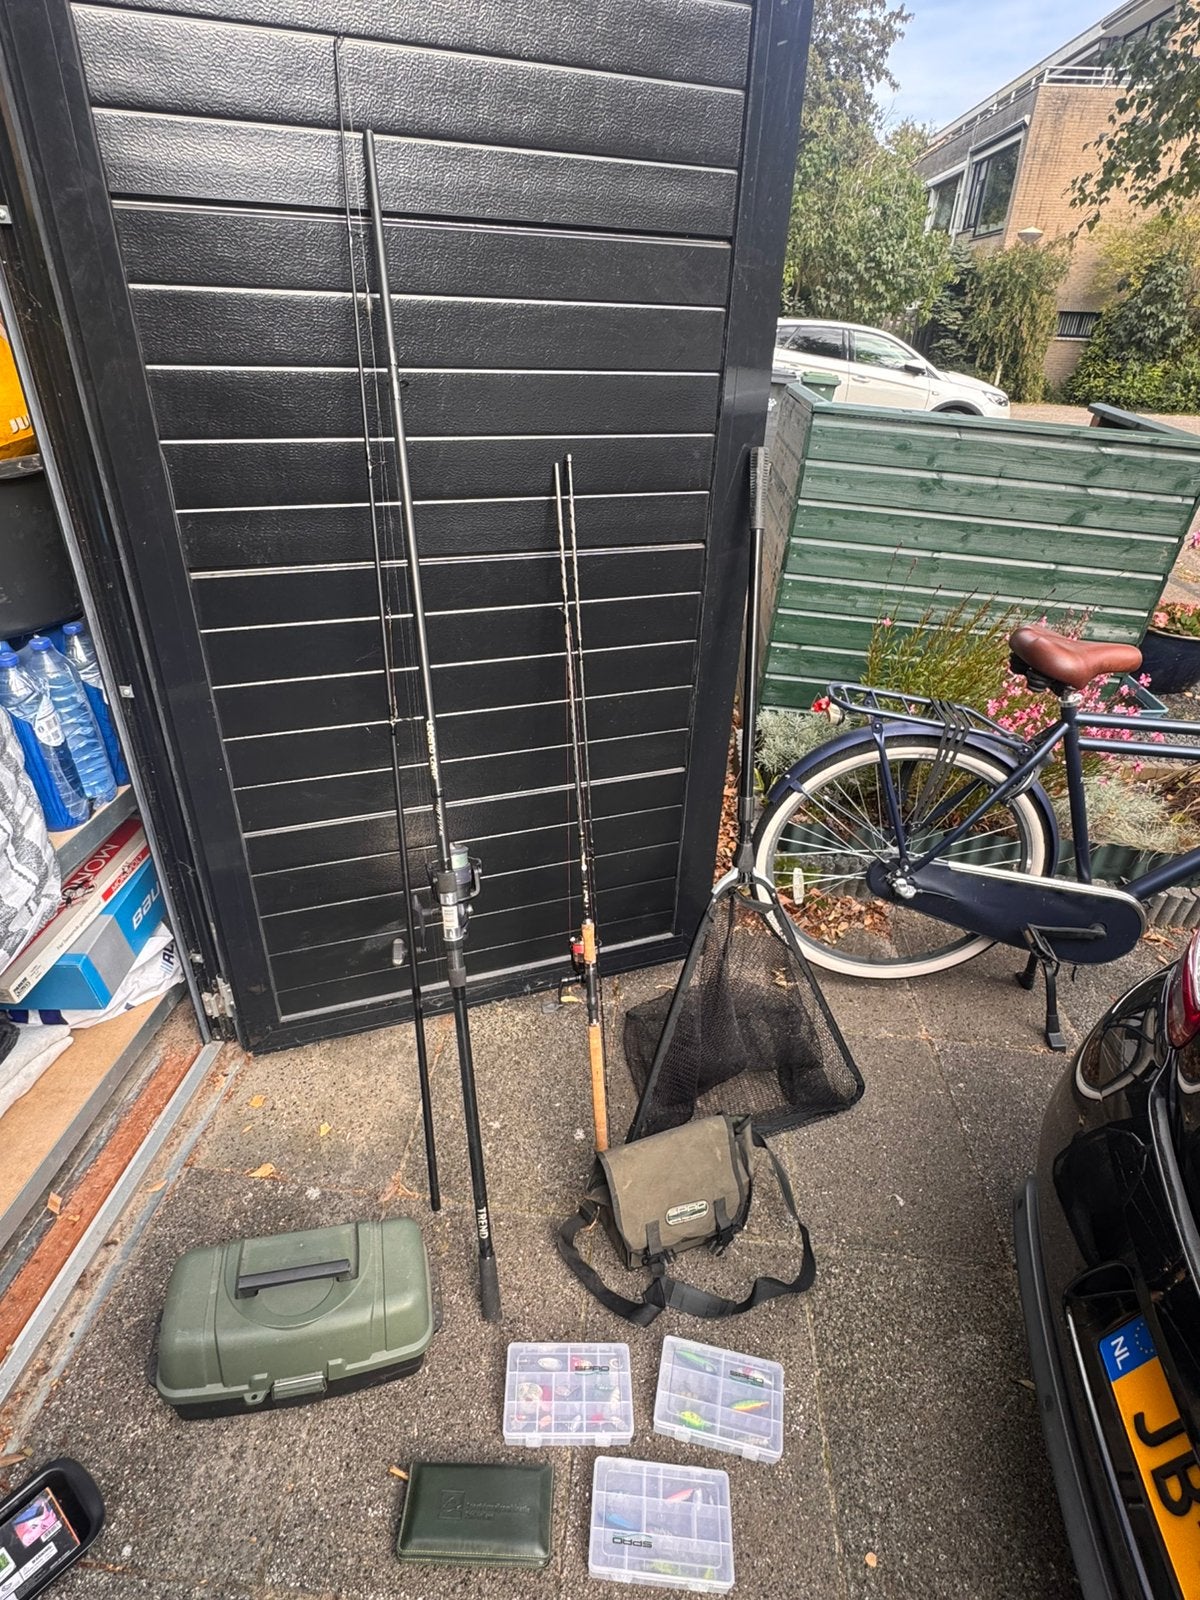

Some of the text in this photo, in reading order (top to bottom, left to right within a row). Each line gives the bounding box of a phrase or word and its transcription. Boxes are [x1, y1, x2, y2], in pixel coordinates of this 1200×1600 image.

[9, 416, 30, 434] JU
[477, 1206, 489, 1239] TREND
[1110, 1335, 1130, 1370] NL
[1134, 1412, 1200, 1516] JB
[612, 1536, 653, 1549] SPRO
